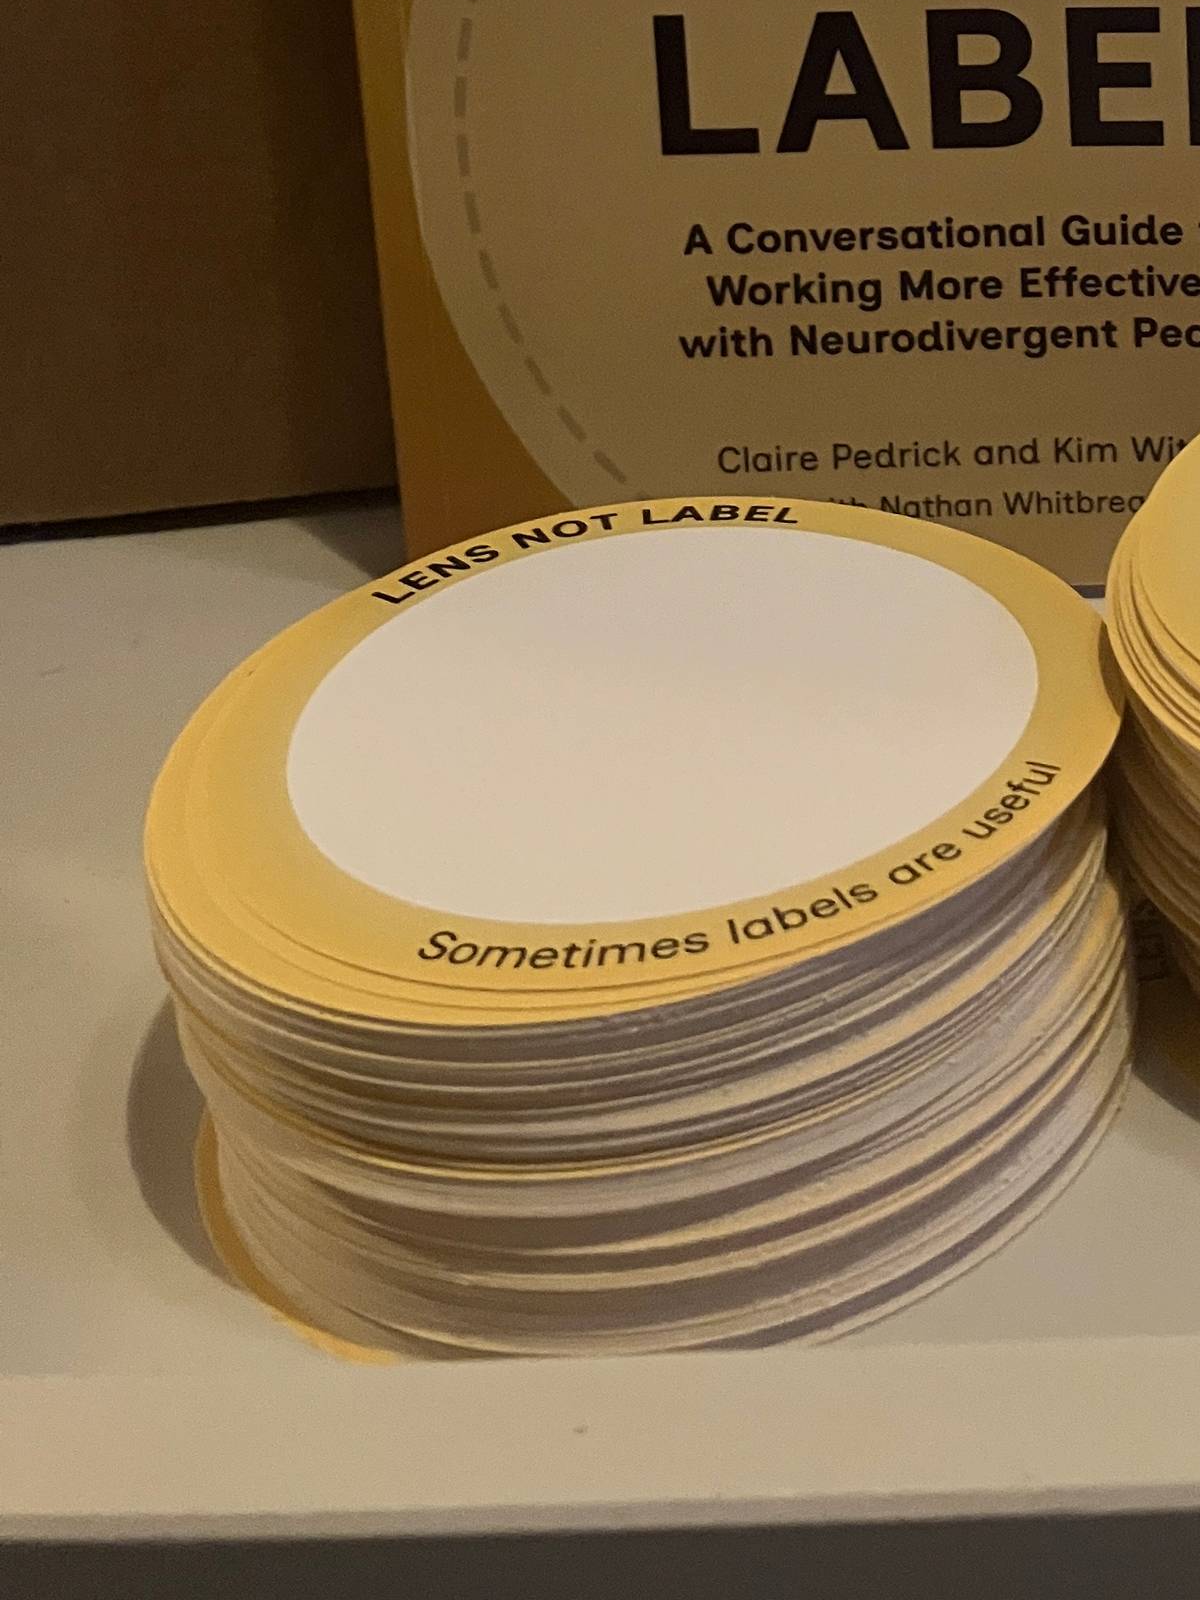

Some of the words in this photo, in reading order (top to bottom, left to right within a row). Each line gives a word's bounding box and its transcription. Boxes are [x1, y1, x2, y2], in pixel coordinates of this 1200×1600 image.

[684, 224, 712, 255] A
[726, 216, 1045, 255] Conversational
[1061, 213, 1184, 247] Guide
[706, 272, 882, 311] Working
[899, 269, 1003, 301] More
[679, 326, 773, 359] with
[790, 319, 1118, 359] Neurodivergent
[717, 445, 819, 474] Claire
[832, 440, 961, 470] Pedrick
[974, 438, 1040, 466] and
[1054, 436, 1118, 463] Kim
[880, 494, 993, 518] Nathan
[1003, 491, 1146, 515] Whitbrea
[371, 544, 499, 604] LENS
[511, 512, 618, 550] NOT
[642, 504, 798, 525] LABEL
[417, 928, 711, 970] Sometimes
[726, 881, 879, 942] labels
[887, 839, 962, 887] are
[962, 760, 1062, 841] useful
